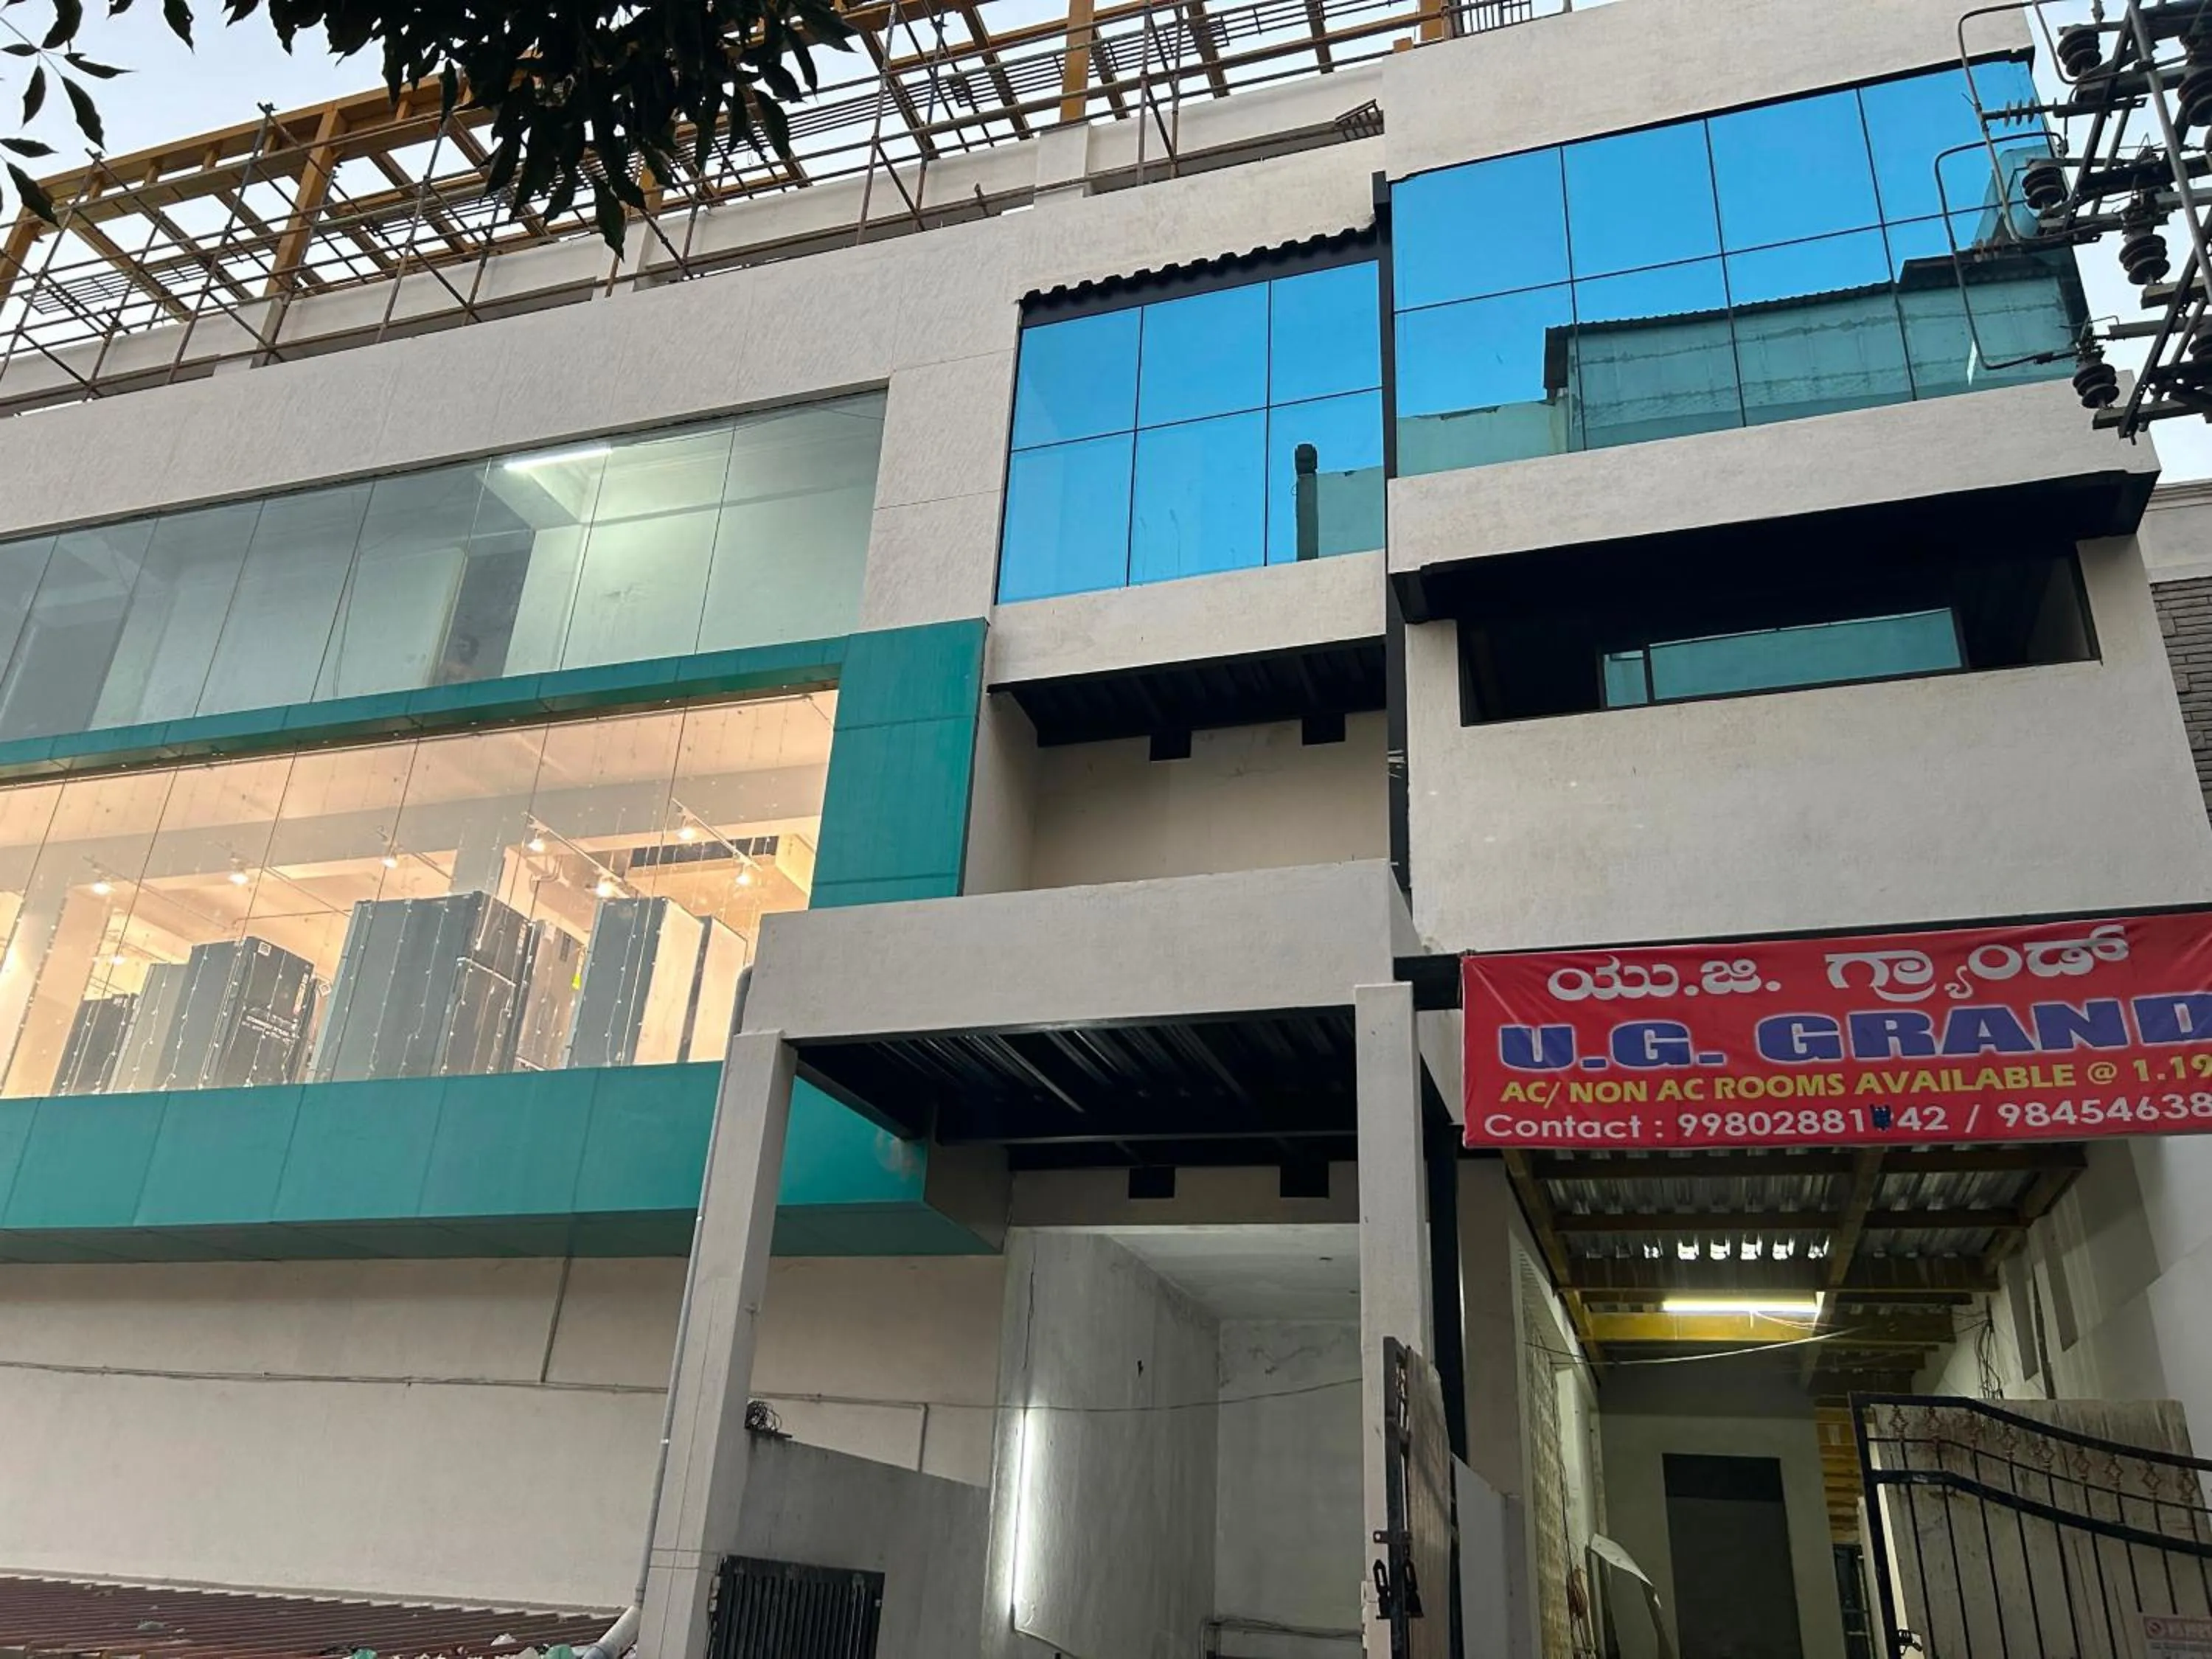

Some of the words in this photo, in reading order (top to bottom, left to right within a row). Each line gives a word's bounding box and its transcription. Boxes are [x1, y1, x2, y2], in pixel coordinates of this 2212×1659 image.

[1499, 1020, 1727, 1072] U.G.
[1756, 992, 2212, 1064] GRAND
[1570, 1081, 1647, 1102] NON
[1657, 1078, 1704, 1101] AC
[1714, 1074, 1846, 1100] ROOMS
[1854, 1064, 2076, 1095] AVAILABLE
[2087, 1062, 2118, 1085] @
[1484, 1114, 1641, 1139] Contact
[1678, 1105, 1949, 1138] 9980288142
[1965, 1105, 1980, 1133] /
[1997, 1092, 2212, 1127] 98454638
